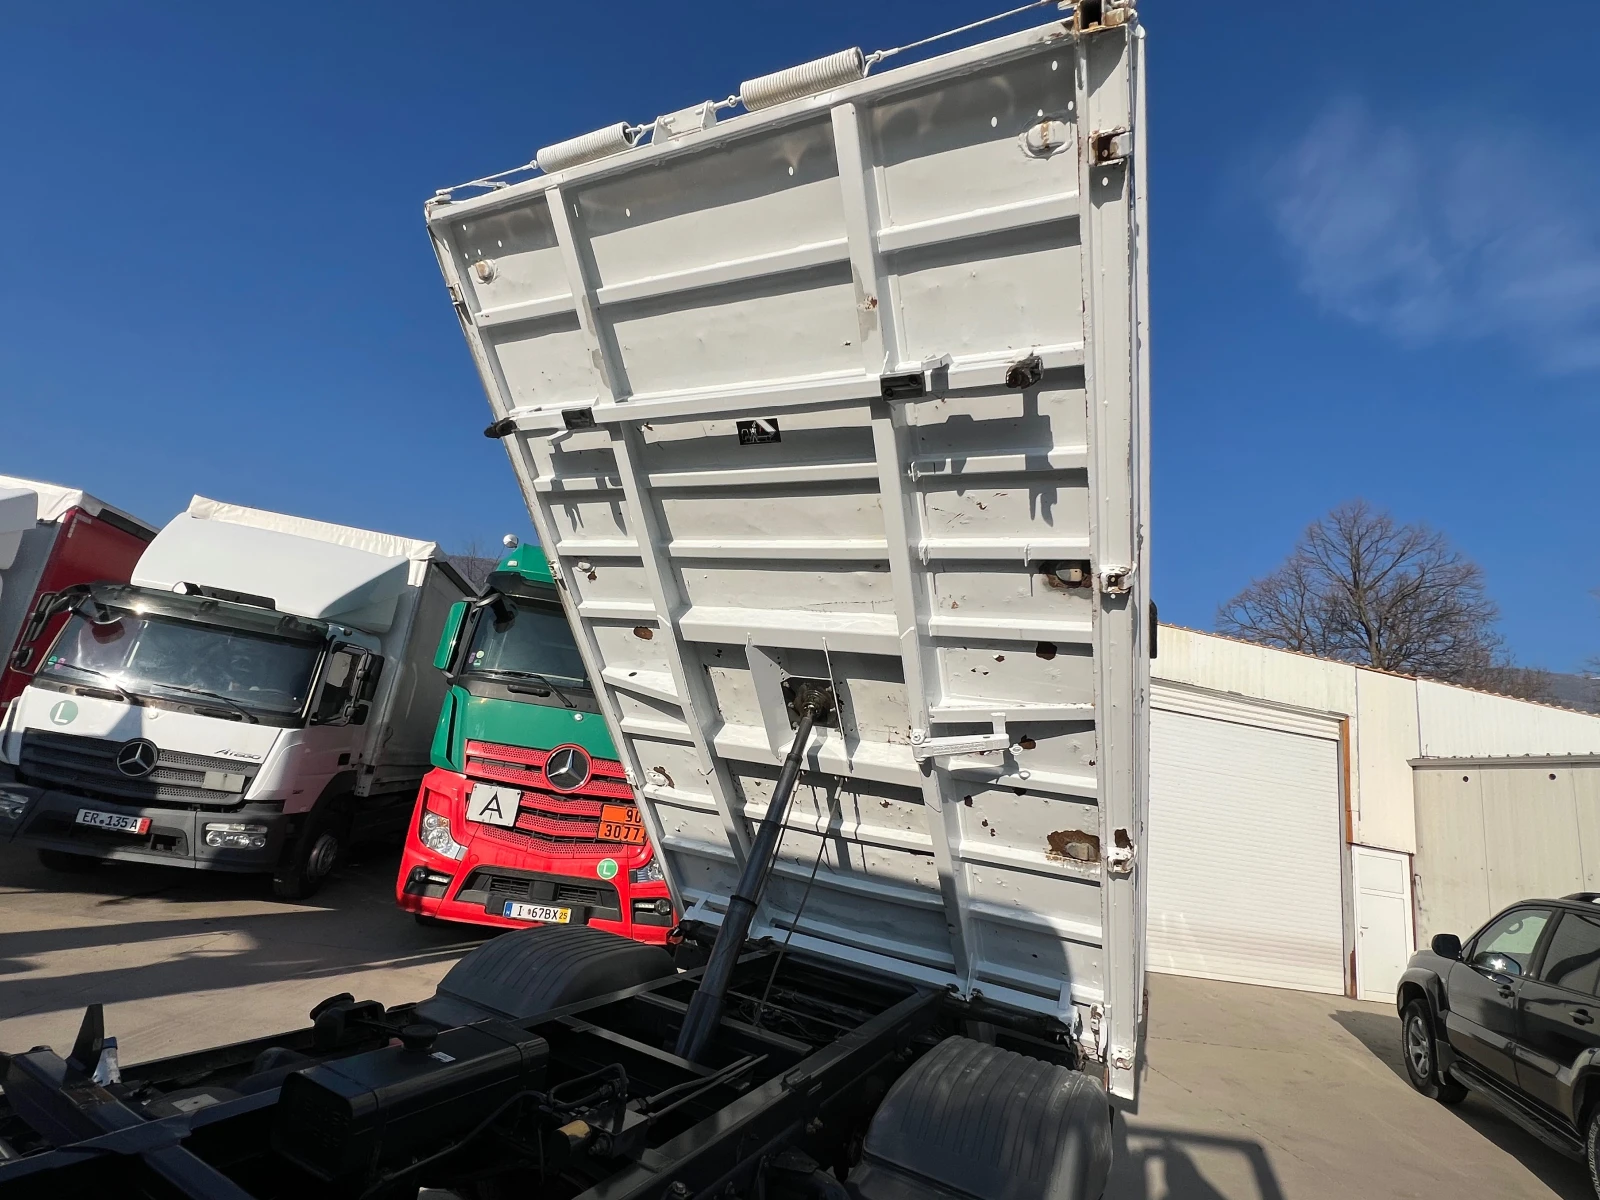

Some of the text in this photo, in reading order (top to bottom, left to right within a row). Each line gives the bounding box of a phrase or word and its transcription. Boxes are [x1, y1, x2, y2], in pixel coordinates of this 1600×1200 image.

[54, 702, 68, 723] L
[479, 791, 503, 819] A
[129, 819, 138, 830] A
[604, 824, 640, 841] 3077
[603, 862, 611, 876] L
[559, 912, 568, 920] 25
